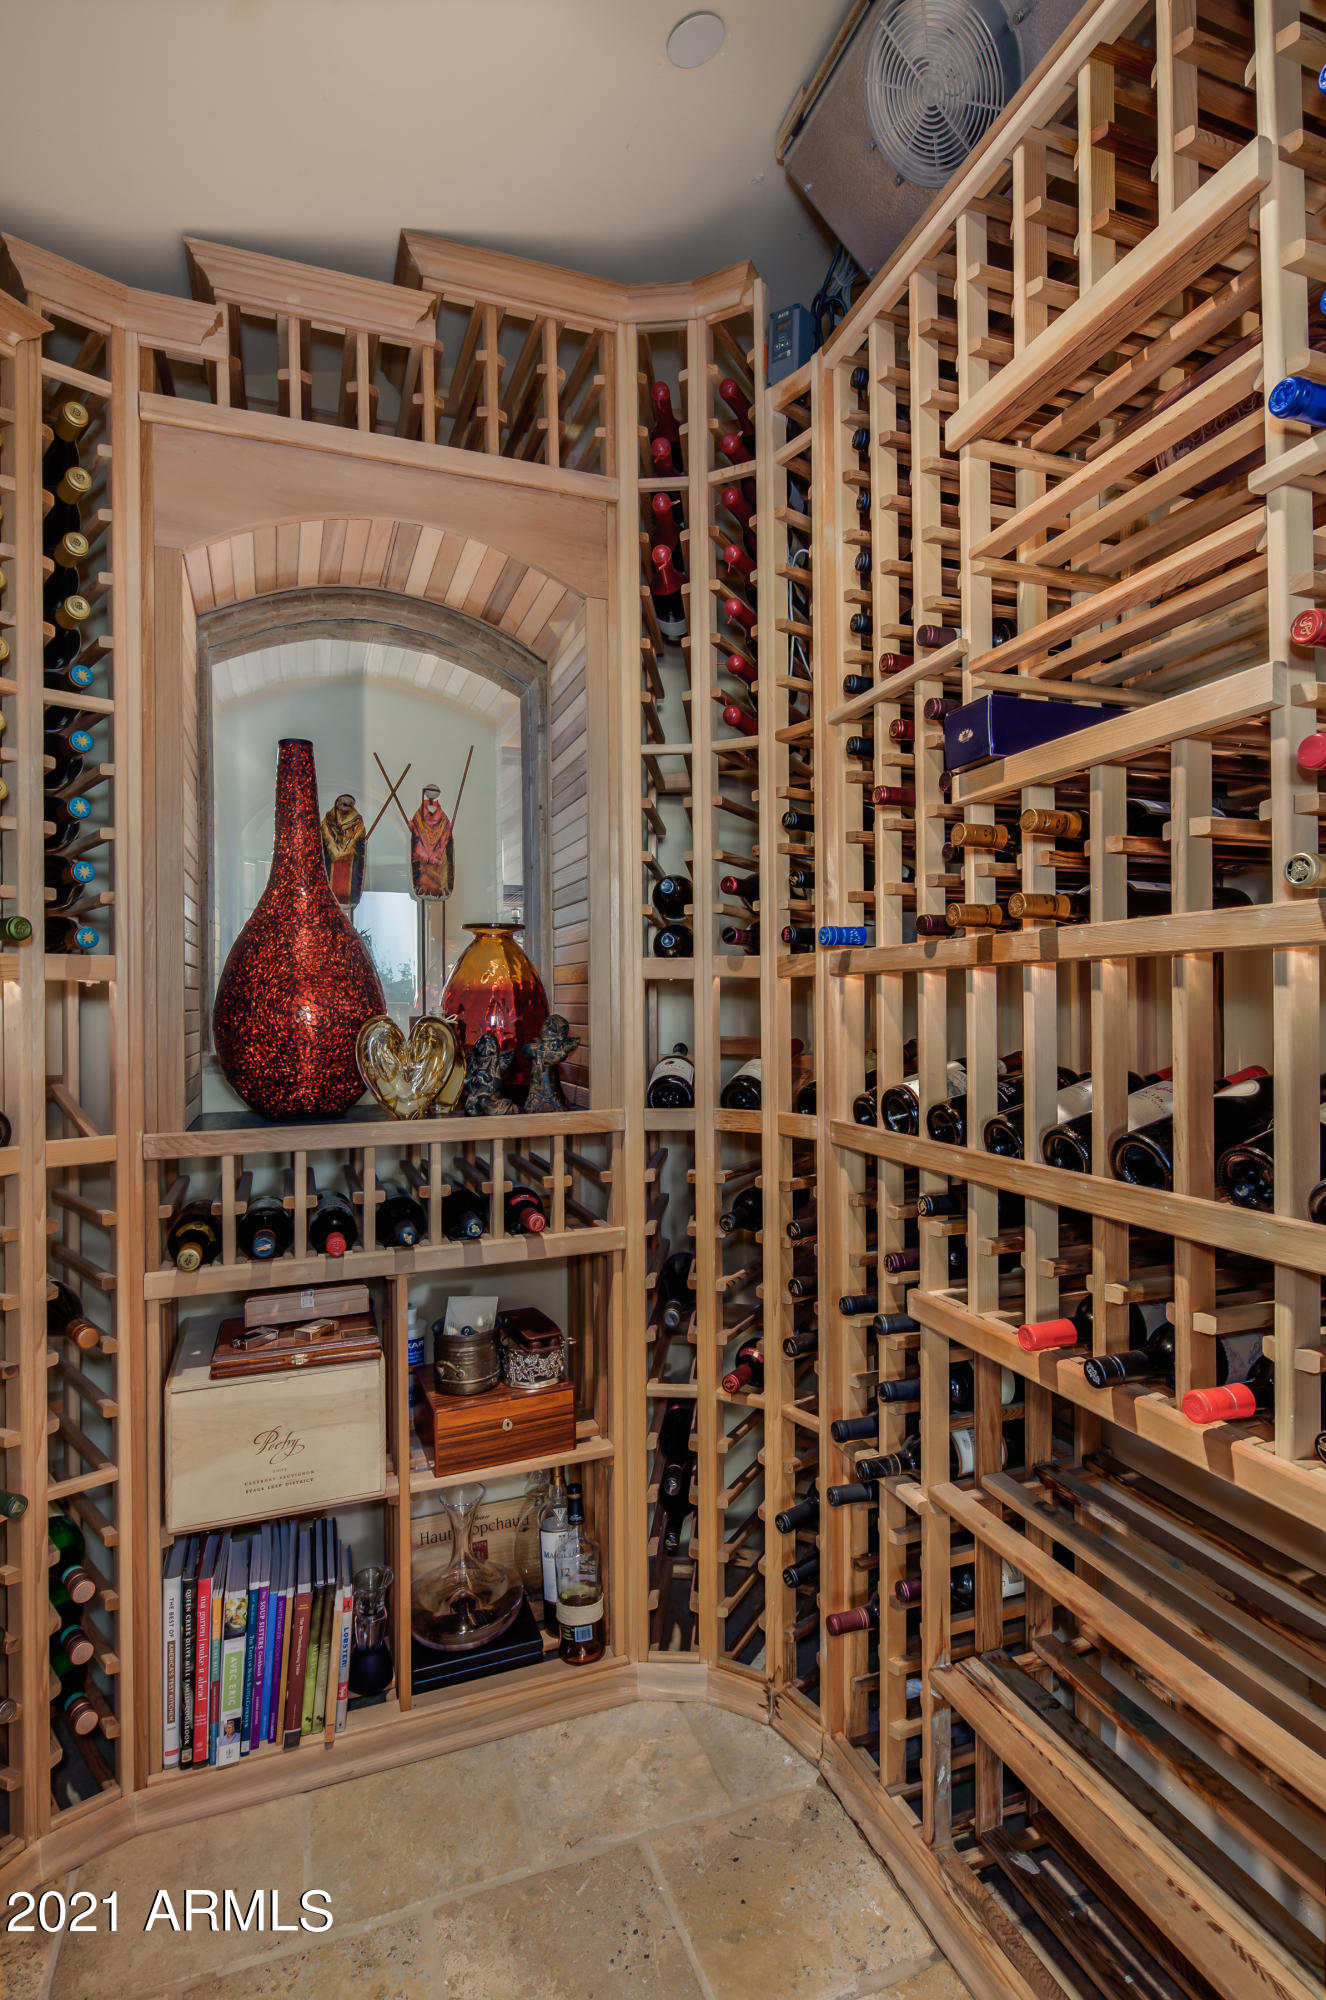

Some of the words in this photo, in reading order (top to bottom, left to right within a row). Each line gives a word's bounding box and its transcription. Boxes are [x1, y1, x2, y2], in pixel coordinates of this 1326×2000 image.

[285, 1477, 314, 1487] DISTRICT
[420, 1530, 453, 1546] Haut
[200, 1595, 208, 1609] ina
[168, 1630, 175, 1638] OF
[198, 1611, 206, 1637] garten
[257, 1621, 265, 1650] SISTERS
[198, 1643, 207, 1666] make
[229, 1656, 238, 1681] AVEC
[167, 1678, 175, 1694] TEST
[197, 1676, 207, 1702] ahead
[227, 1684, 237, 1706] ERIC
[167, 1695, 175, 1722] KITCHEN
